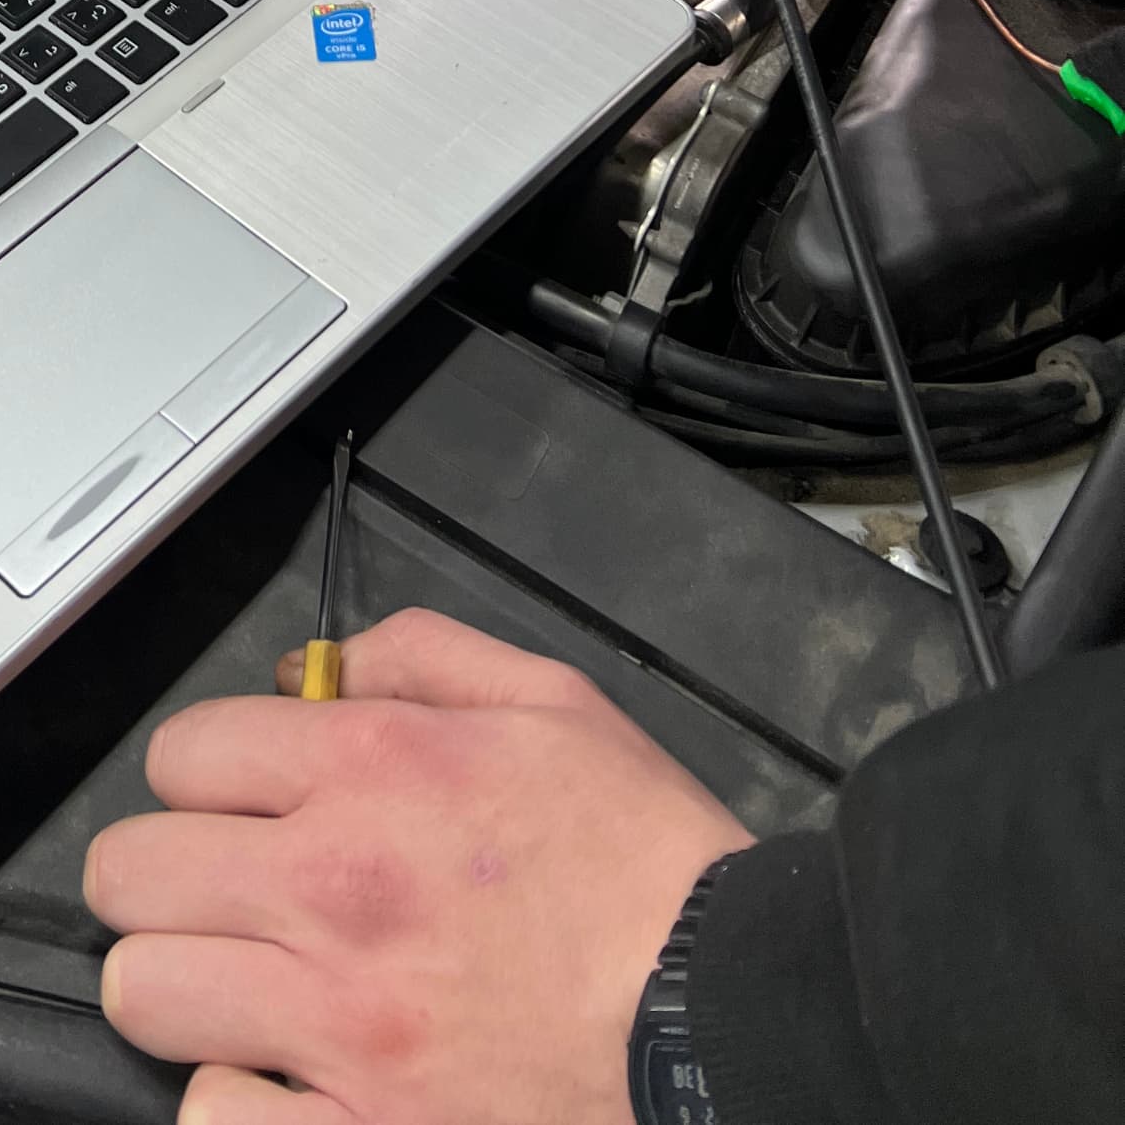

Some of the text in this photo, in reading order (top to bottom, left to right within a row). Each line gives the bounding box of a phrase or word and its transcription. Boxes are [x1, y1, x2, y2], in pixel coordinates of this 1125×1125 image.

[161, 2, 179, 15] ctrl
[325, 17, 359, 30] intel
[325, 44, 353, 53] CORE
[62, 80, 79, 92] alt
